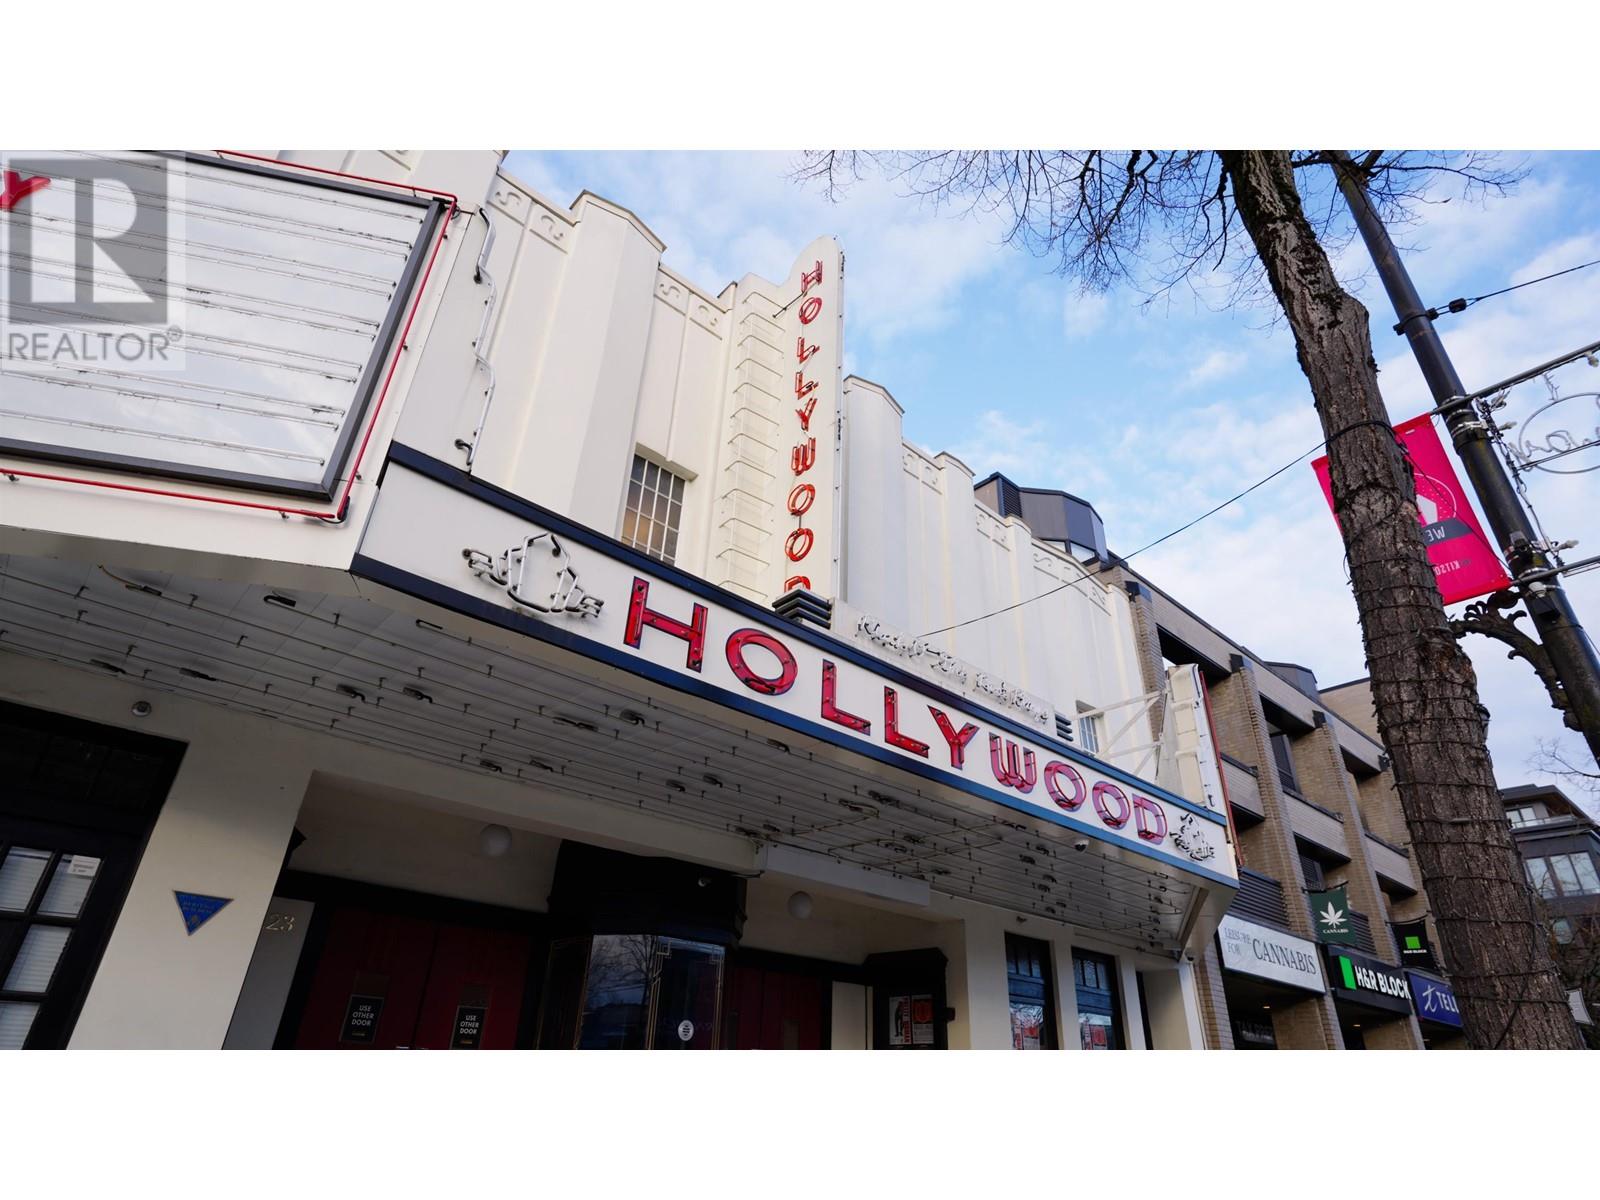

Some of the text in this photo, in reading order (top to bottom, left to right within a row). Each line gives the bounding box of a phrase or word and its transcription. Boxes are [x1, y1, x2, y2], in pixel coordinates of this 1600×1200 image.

[623, 576, 1168, 845] HOLLYWOOD
[1252, 938, 1316, 975] CANNABIS
[1355, 965, 1412, 1000] H&R BLOCK
[352, 1011, 374, 1019] OTHER
